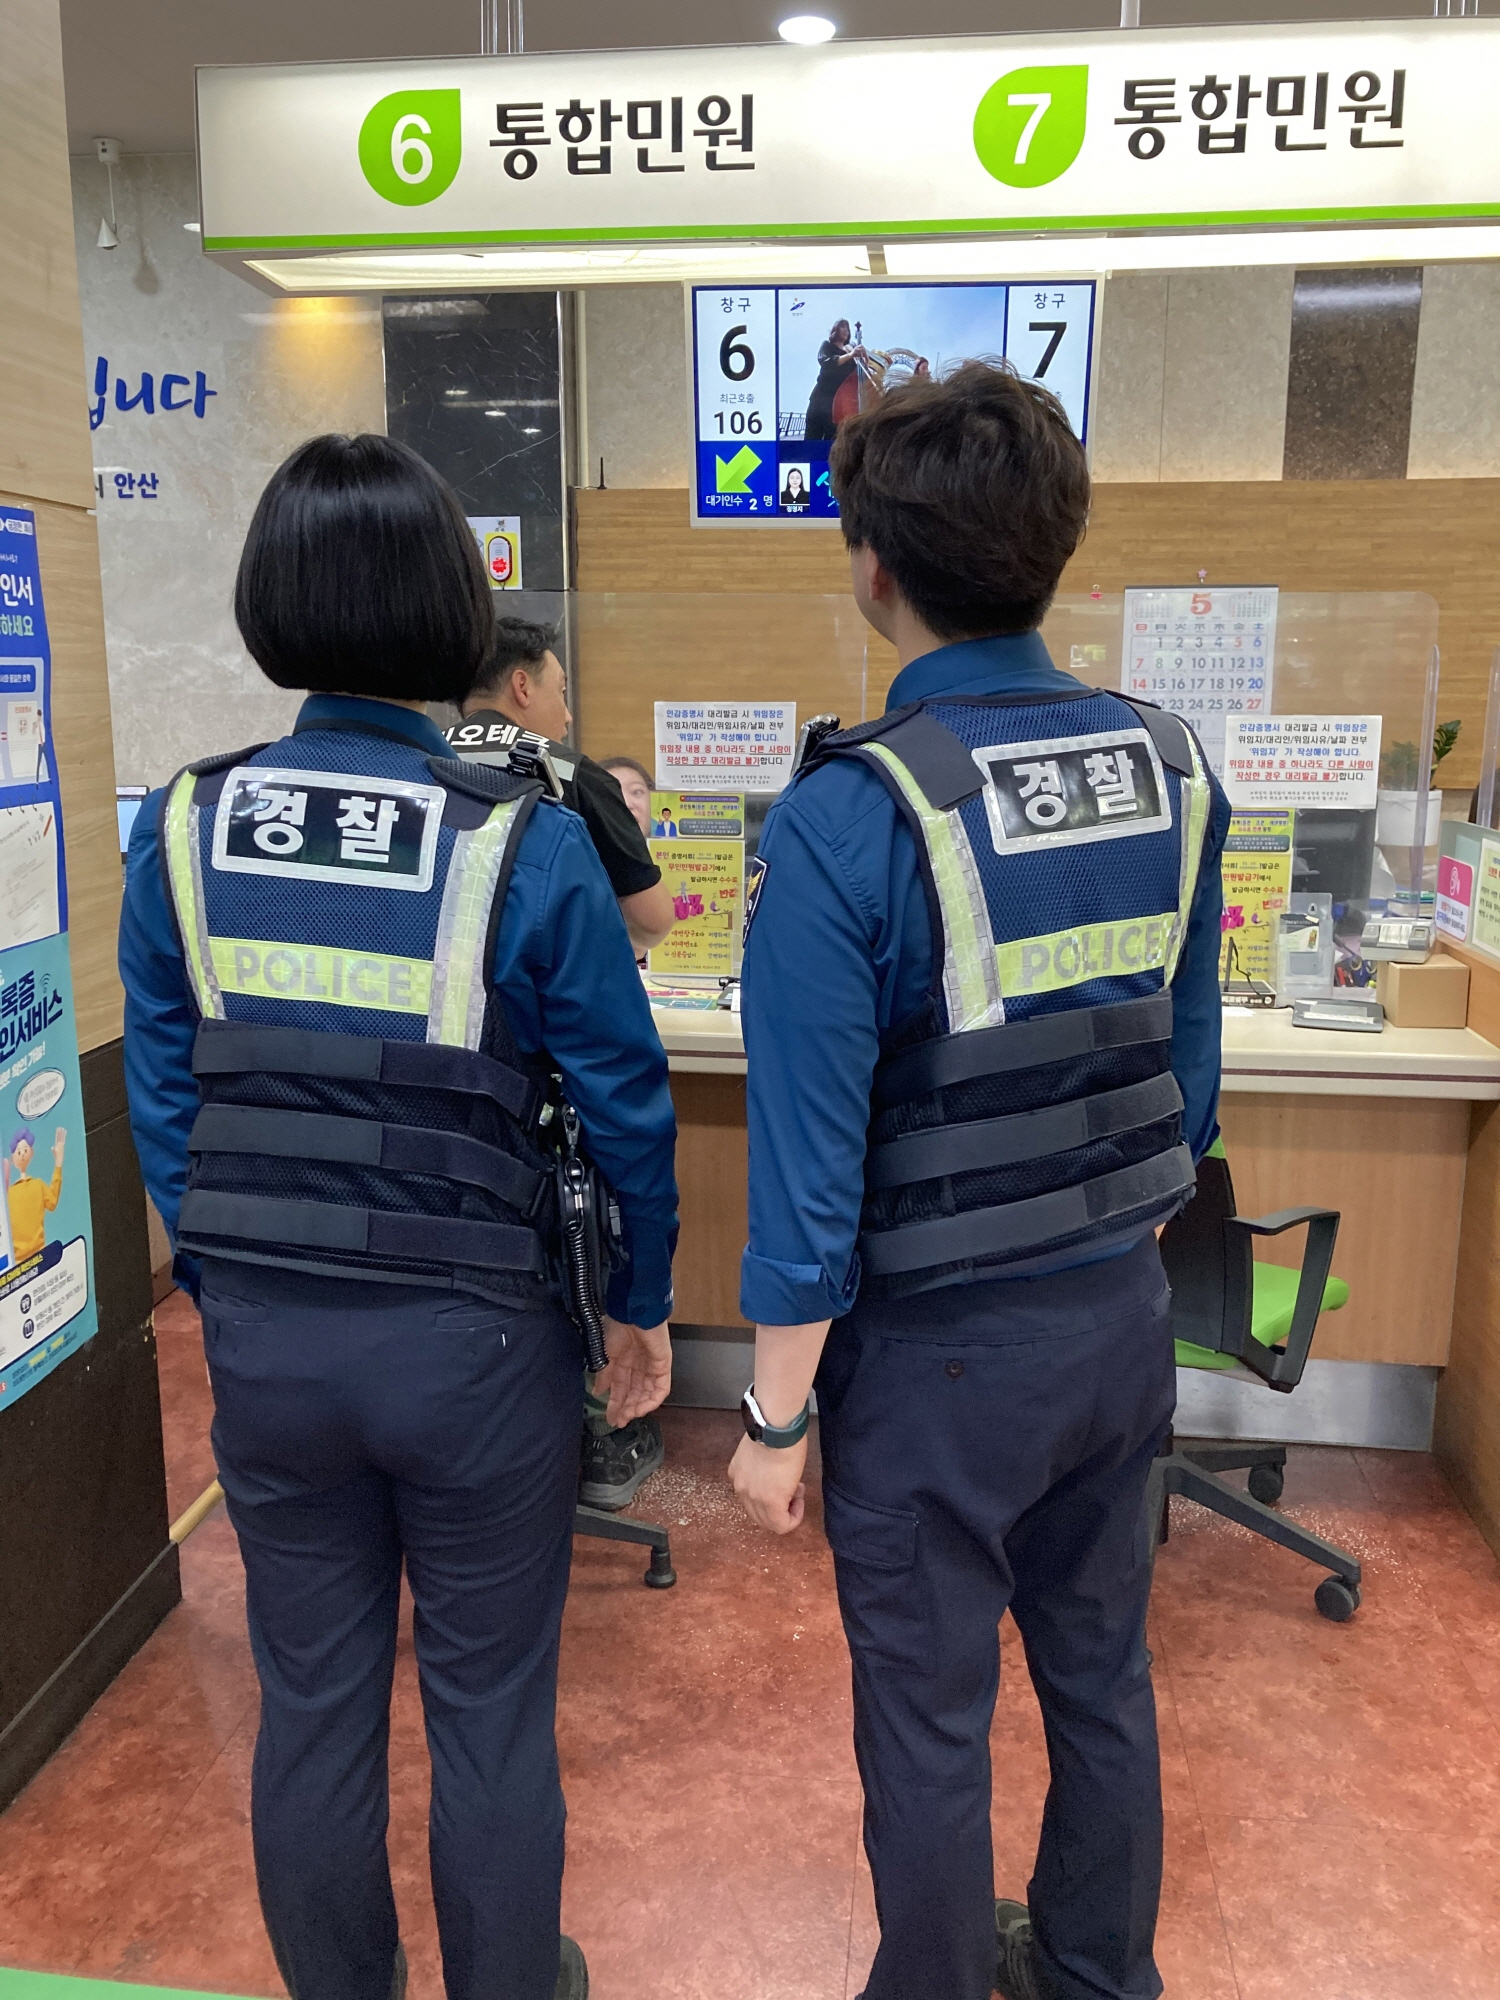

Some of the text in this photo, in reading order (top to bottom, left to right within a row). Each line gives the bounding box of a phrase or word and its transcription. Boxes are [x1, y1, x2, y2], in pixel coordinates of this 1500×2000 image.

[1115, 69, 1407, 160] 통합민원
[1007, 93, 1053, 164] 7
[489, 94, 756, 181] 통합민원
[391, 114, 432, 184] 6
[719, 325, 755, 381] 6
[1028, 322, 1068, 378] 7
[720, 393, 755, 404] 최근호출
[714, 410, 763, 435] 106
[114, 472, 159, 499] 안산
[705, 494, 773, 511] 대기인수 2 명
[1190, 592, 1212, 616] 5
[1158, 637, 1262, 648] 1 2 3 4 5 6
[1136, 657, 1264, 669] 7 8 9 10 11 12 13
[1132, 678, 1263, 690] 14 15 16 17 18 19 20
[1169, 699, 1184, 710] 23
[1188, 699, 1204, 710] 24
[1208, 699, 1223, 710] 25
[1227, 699, 1243, 710] 26
[1246, 699, 1262, 710] 27
[666, 710, 784, 718] 인감증명서 대리발급 시 위임장은
[769, 721, 784, 730] 전부
[1239, 723, 1368, 732] 인감증명서 대리발급 시 위임장은
[709, 733, 717, 742] 가
[720, 733, 751, 742] 작성해야
[1351, 735, 1367, 744] 전부
[659, 744, 791, 754] 위임장 내용 중 하나라도 다른 사람이
[1285, 747, 1293, 757] 가
[1297, 747, 1330, 757] 작성해야
[666, 756, 689, 765] 작성한
[692, 756, 707, 765] 경우
[711, 756, 741, 765] 대리발급
[1229, 759, 1373, 769] 위임장 내용 중 하나라도 다른 사람이
[1235, 772, 1260, 781] 작성한
[1265, 772, 1281, 781] 경우
[1285, 772, 1318, 781] 대리발급
[1019, 922, 1162, 988] POLICE
[234, 945, 411, 1006] POLICE
